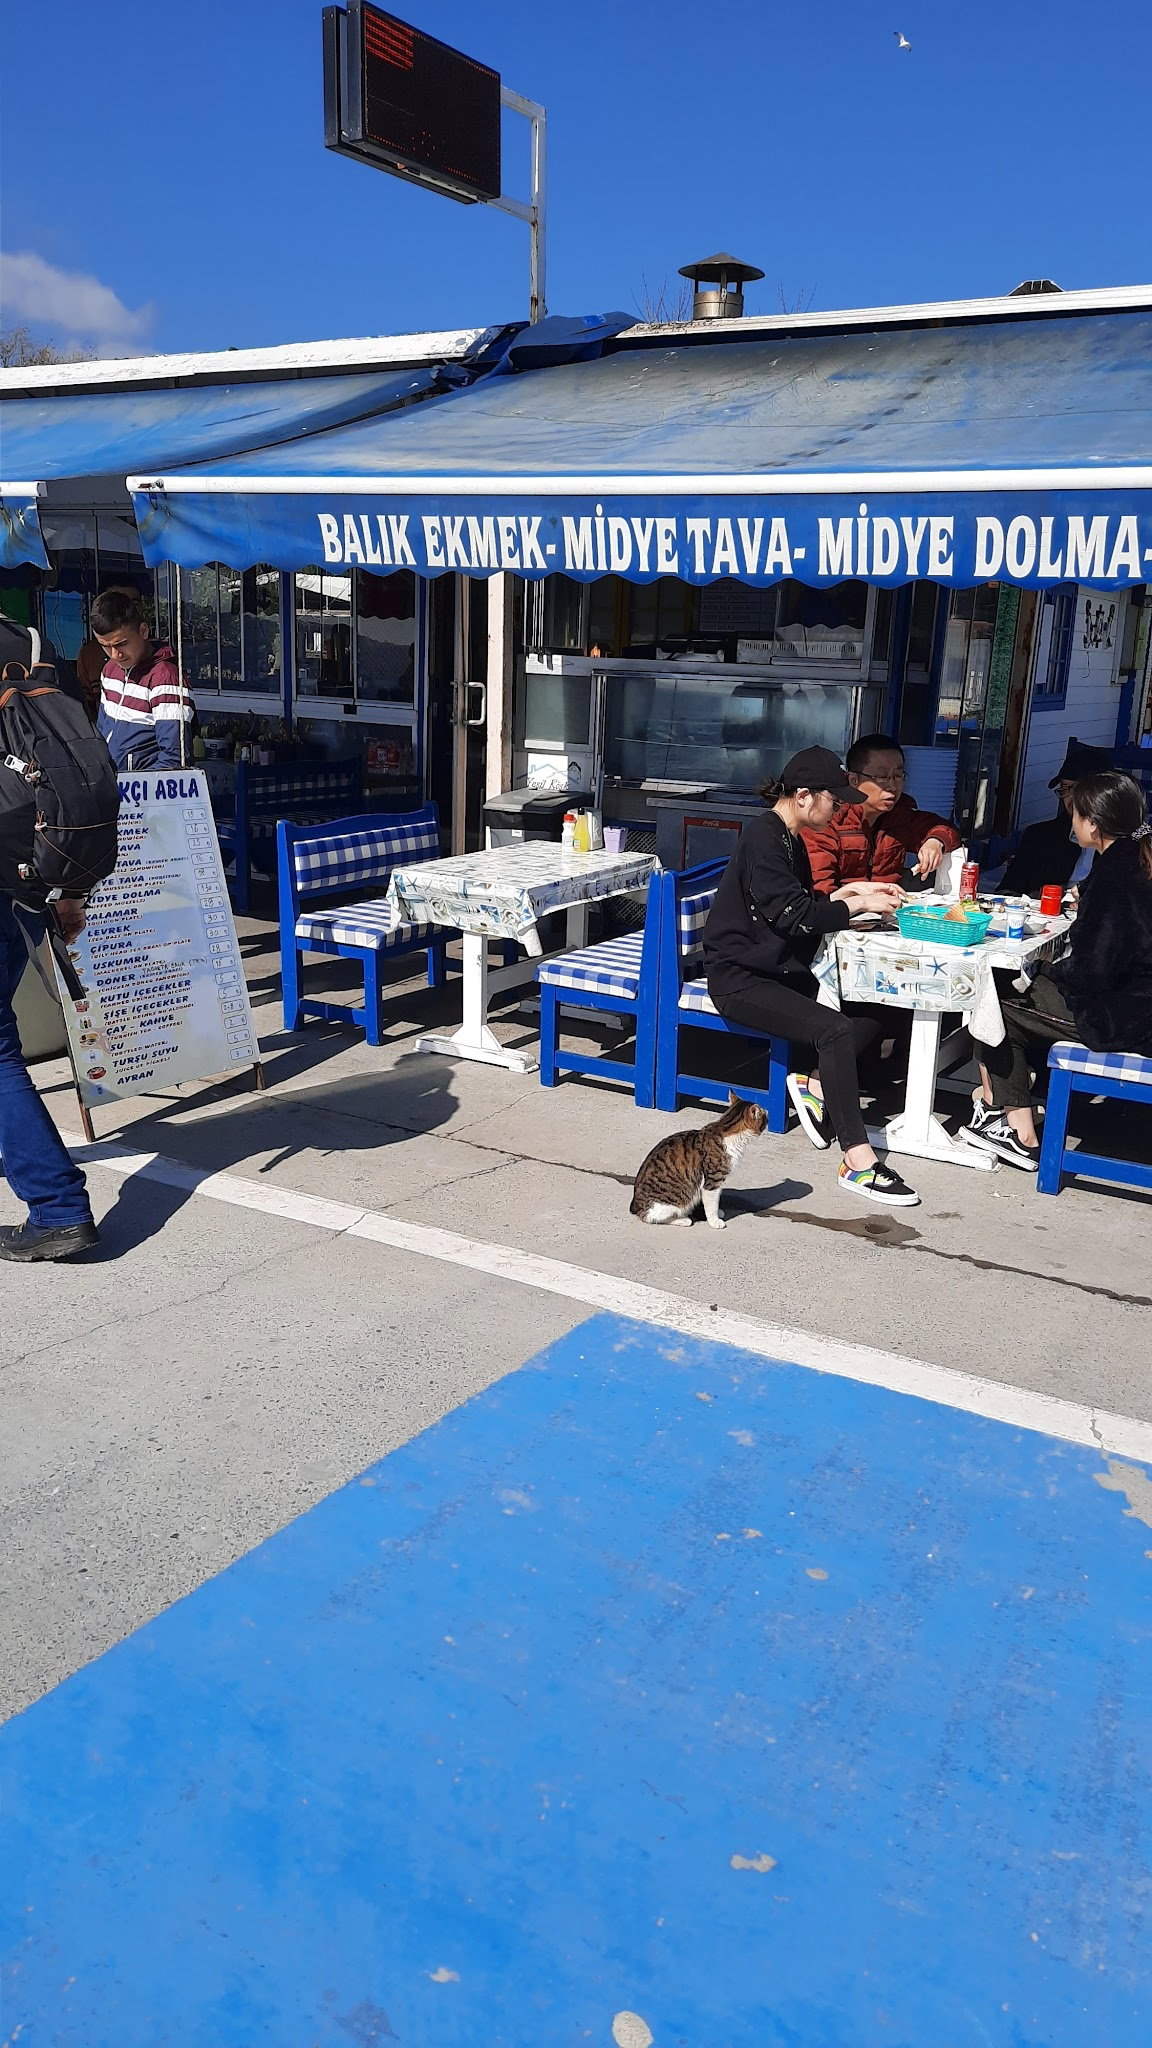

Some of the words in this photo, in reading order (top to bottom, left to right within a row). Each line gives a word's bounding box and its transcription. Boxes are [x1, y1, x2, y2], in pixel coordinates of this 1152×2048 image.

[317, 513, 417, 566] BALIK
[562, 503, 679, 574] MİDYE
[817, 503, 954, 577] MİDYE
[118, 781, 148, 807] KÇI
[155, 778, 199, 799] ABLA
[117, 813, 144, 821] MEK
[117, 828, 149, 836] KMEK
[116, 844, 141, 852] AVA
[115, 859, 141, 867] TAVA
[119, 875, 144, 884] TAVA
[123, 889, 160, 899] DOLMA
[84, 908, 137, 921] KALAMAR
[88, 925, 130, 937] LEVREK
[90, 941, 132, 954] ÇİPURA
[93, 955, 148, 970] USKUMRU
[97, 974, 135, 986] DÖNER
[100, 992, 130, 1003] KUTU
[134, 980, 191, 996] İÇECEKLER
[104, 1008, 127, 1020] ŞİŞE
[132, 996, 188, 1013] İÇECEKLER
[106, 1025, 126, 1036] ÇAY
[140, 1014, 174, 1027] KAHVE
[109, 1042, 124, 1051] SU
[113, 1053, 148, 1067] TURŞU
[152, 1046, 178, 1058] SUYU
[117, 1070, 153, 1085] AYRAN
